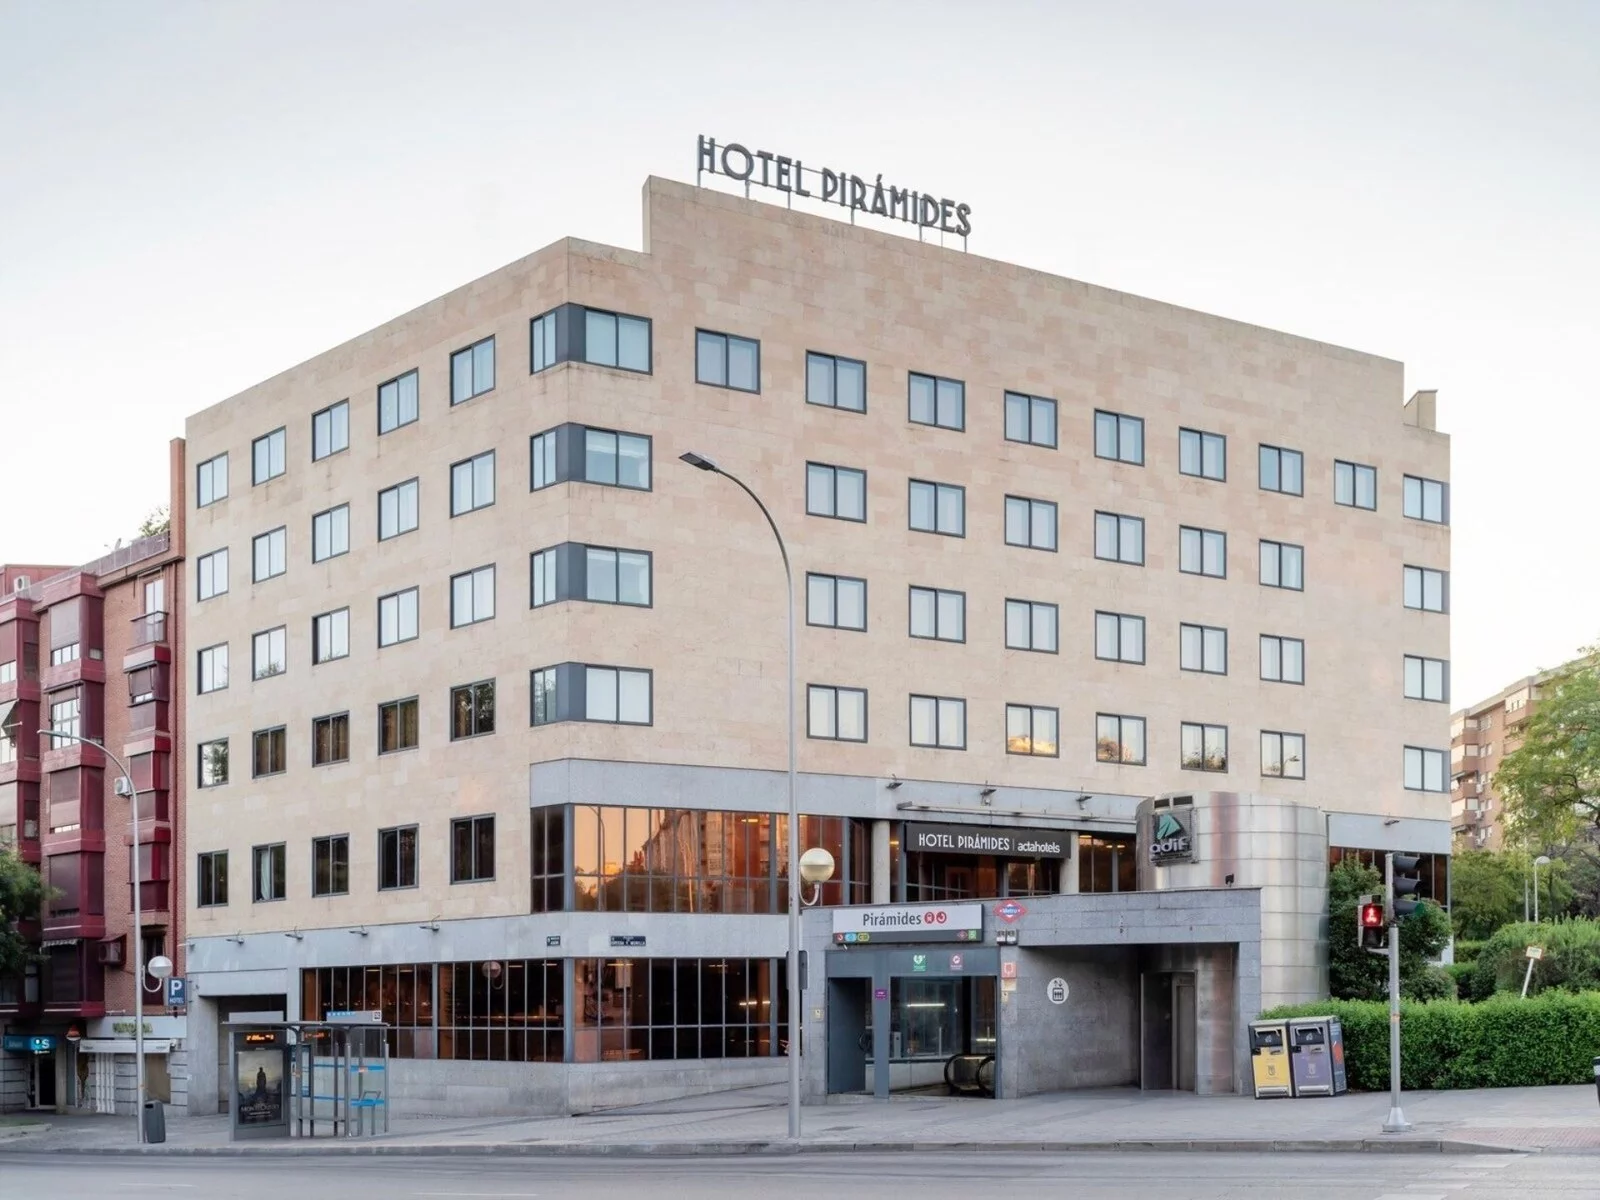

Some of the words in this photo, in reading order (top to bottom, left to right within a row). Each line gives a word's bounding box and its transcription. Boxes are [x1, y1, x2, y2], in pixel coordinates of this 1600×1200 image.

[698, 134, 811, 197] HOTEL
[822, 167, 972, 237] PIRÁMIDES
[918, 832, 955, 848] HOTEL
[957, 832, 1010, 851] PIRÁMIDES
[1017, 840, 1061, 854] actahotels
[1149, 837, 1188, 853] adif
[862, 911, 922, 926] Pirámides
[171, 979, 183, 996] P
